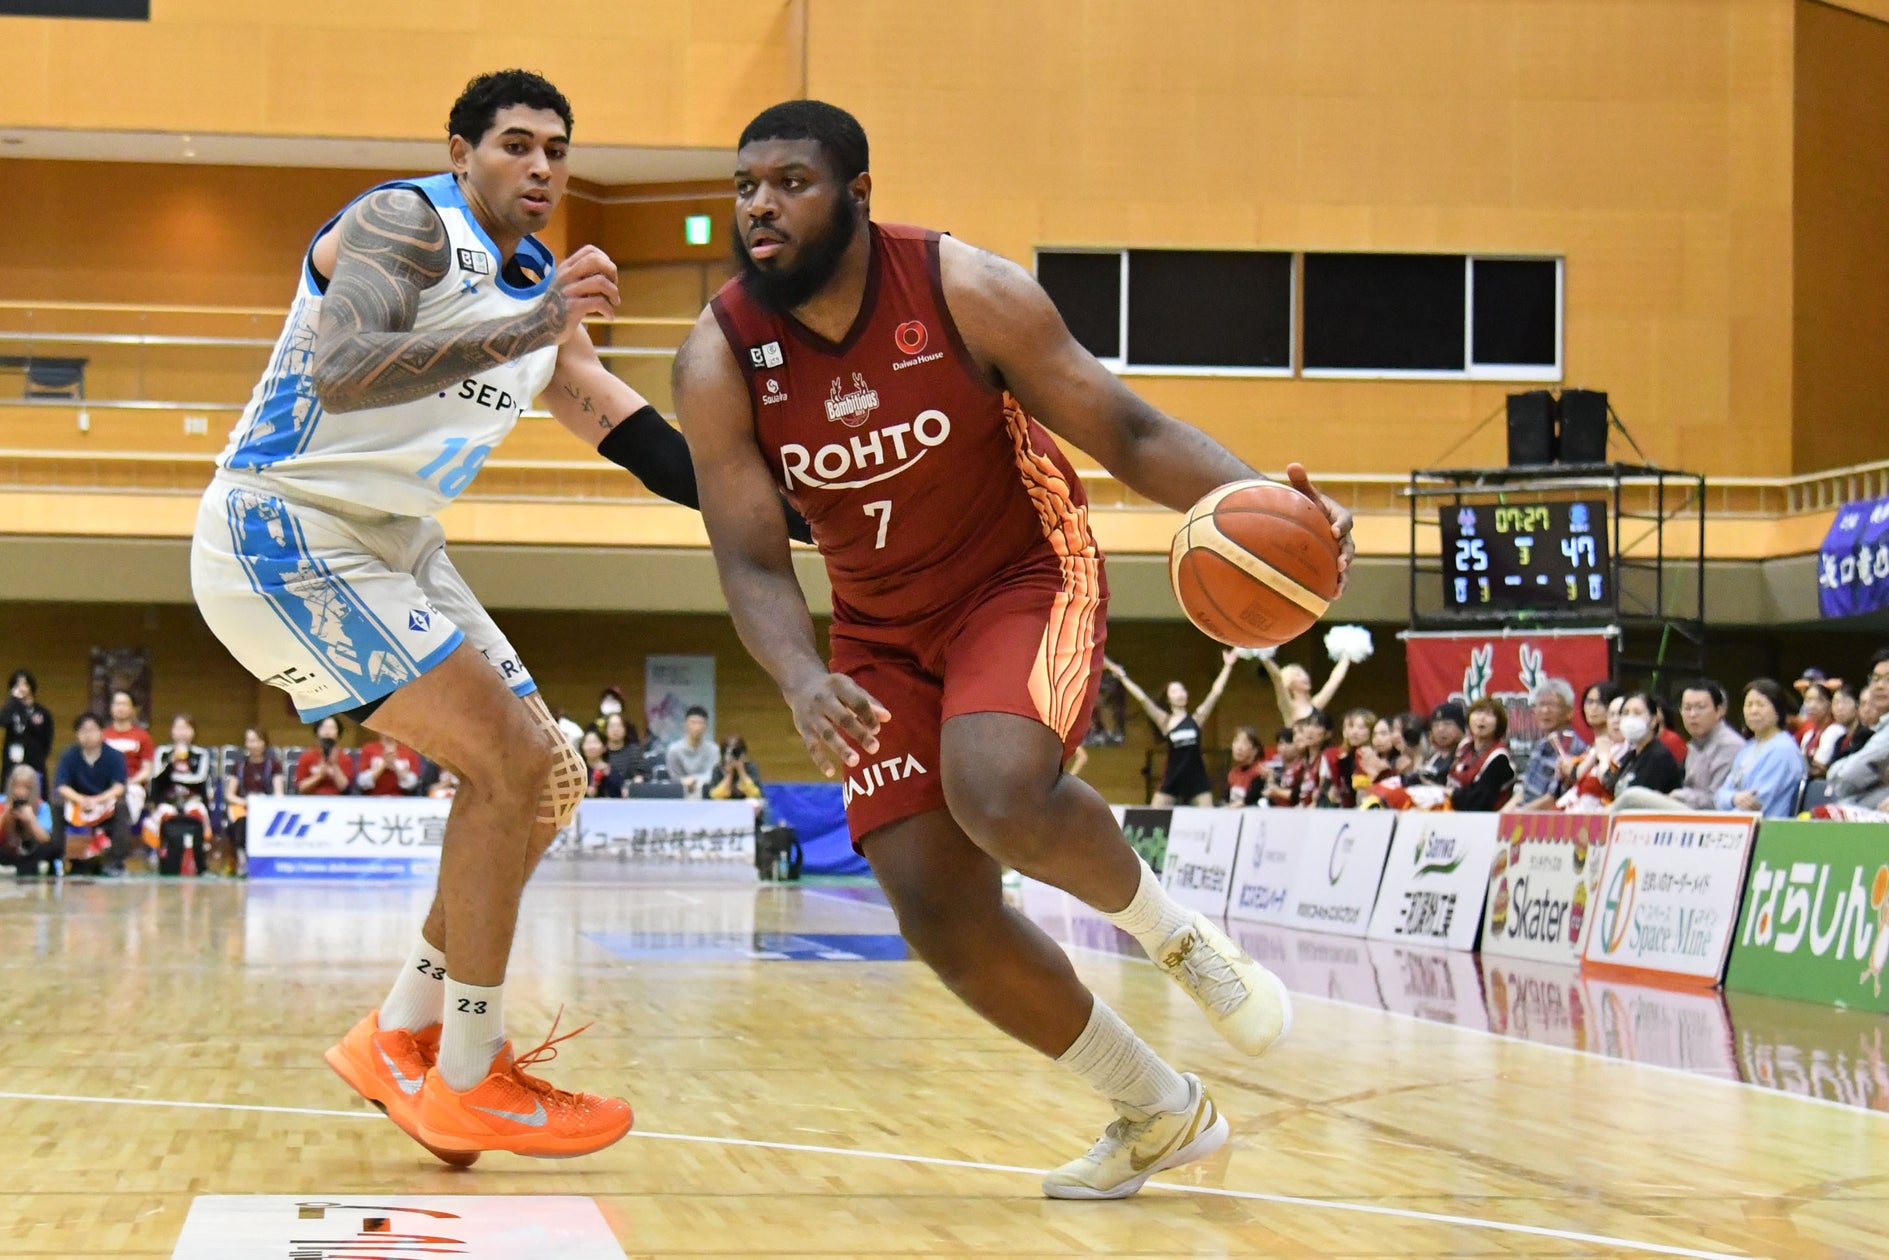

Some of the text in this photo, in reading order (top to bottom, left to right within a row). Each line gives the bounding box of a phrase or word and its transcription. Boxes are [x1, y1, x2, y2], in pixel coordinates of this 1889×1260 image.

[458, 379, 523, 416] SEP
[826, 391, 878, 420] Bambitious
[416, 437, 491, 498] 18
[780, 409, 951, 490] ROHTO
[862, 500, 893, 550] 7
[1495, 506, 1549, 532] 07:27
[1455, 538, 1488, 571] 25
[1561, 535, 1595, 568] 47
[843, 753, 927, 809] AJITA
[1508, 875, 1569, 944] Skater
[1629, 903, 1712, 957] Space Mine
[1741, 860, 1873, 961] ならしん
[416, 958, 446, 981] 23
[457, 998, 488, 1015] 23
